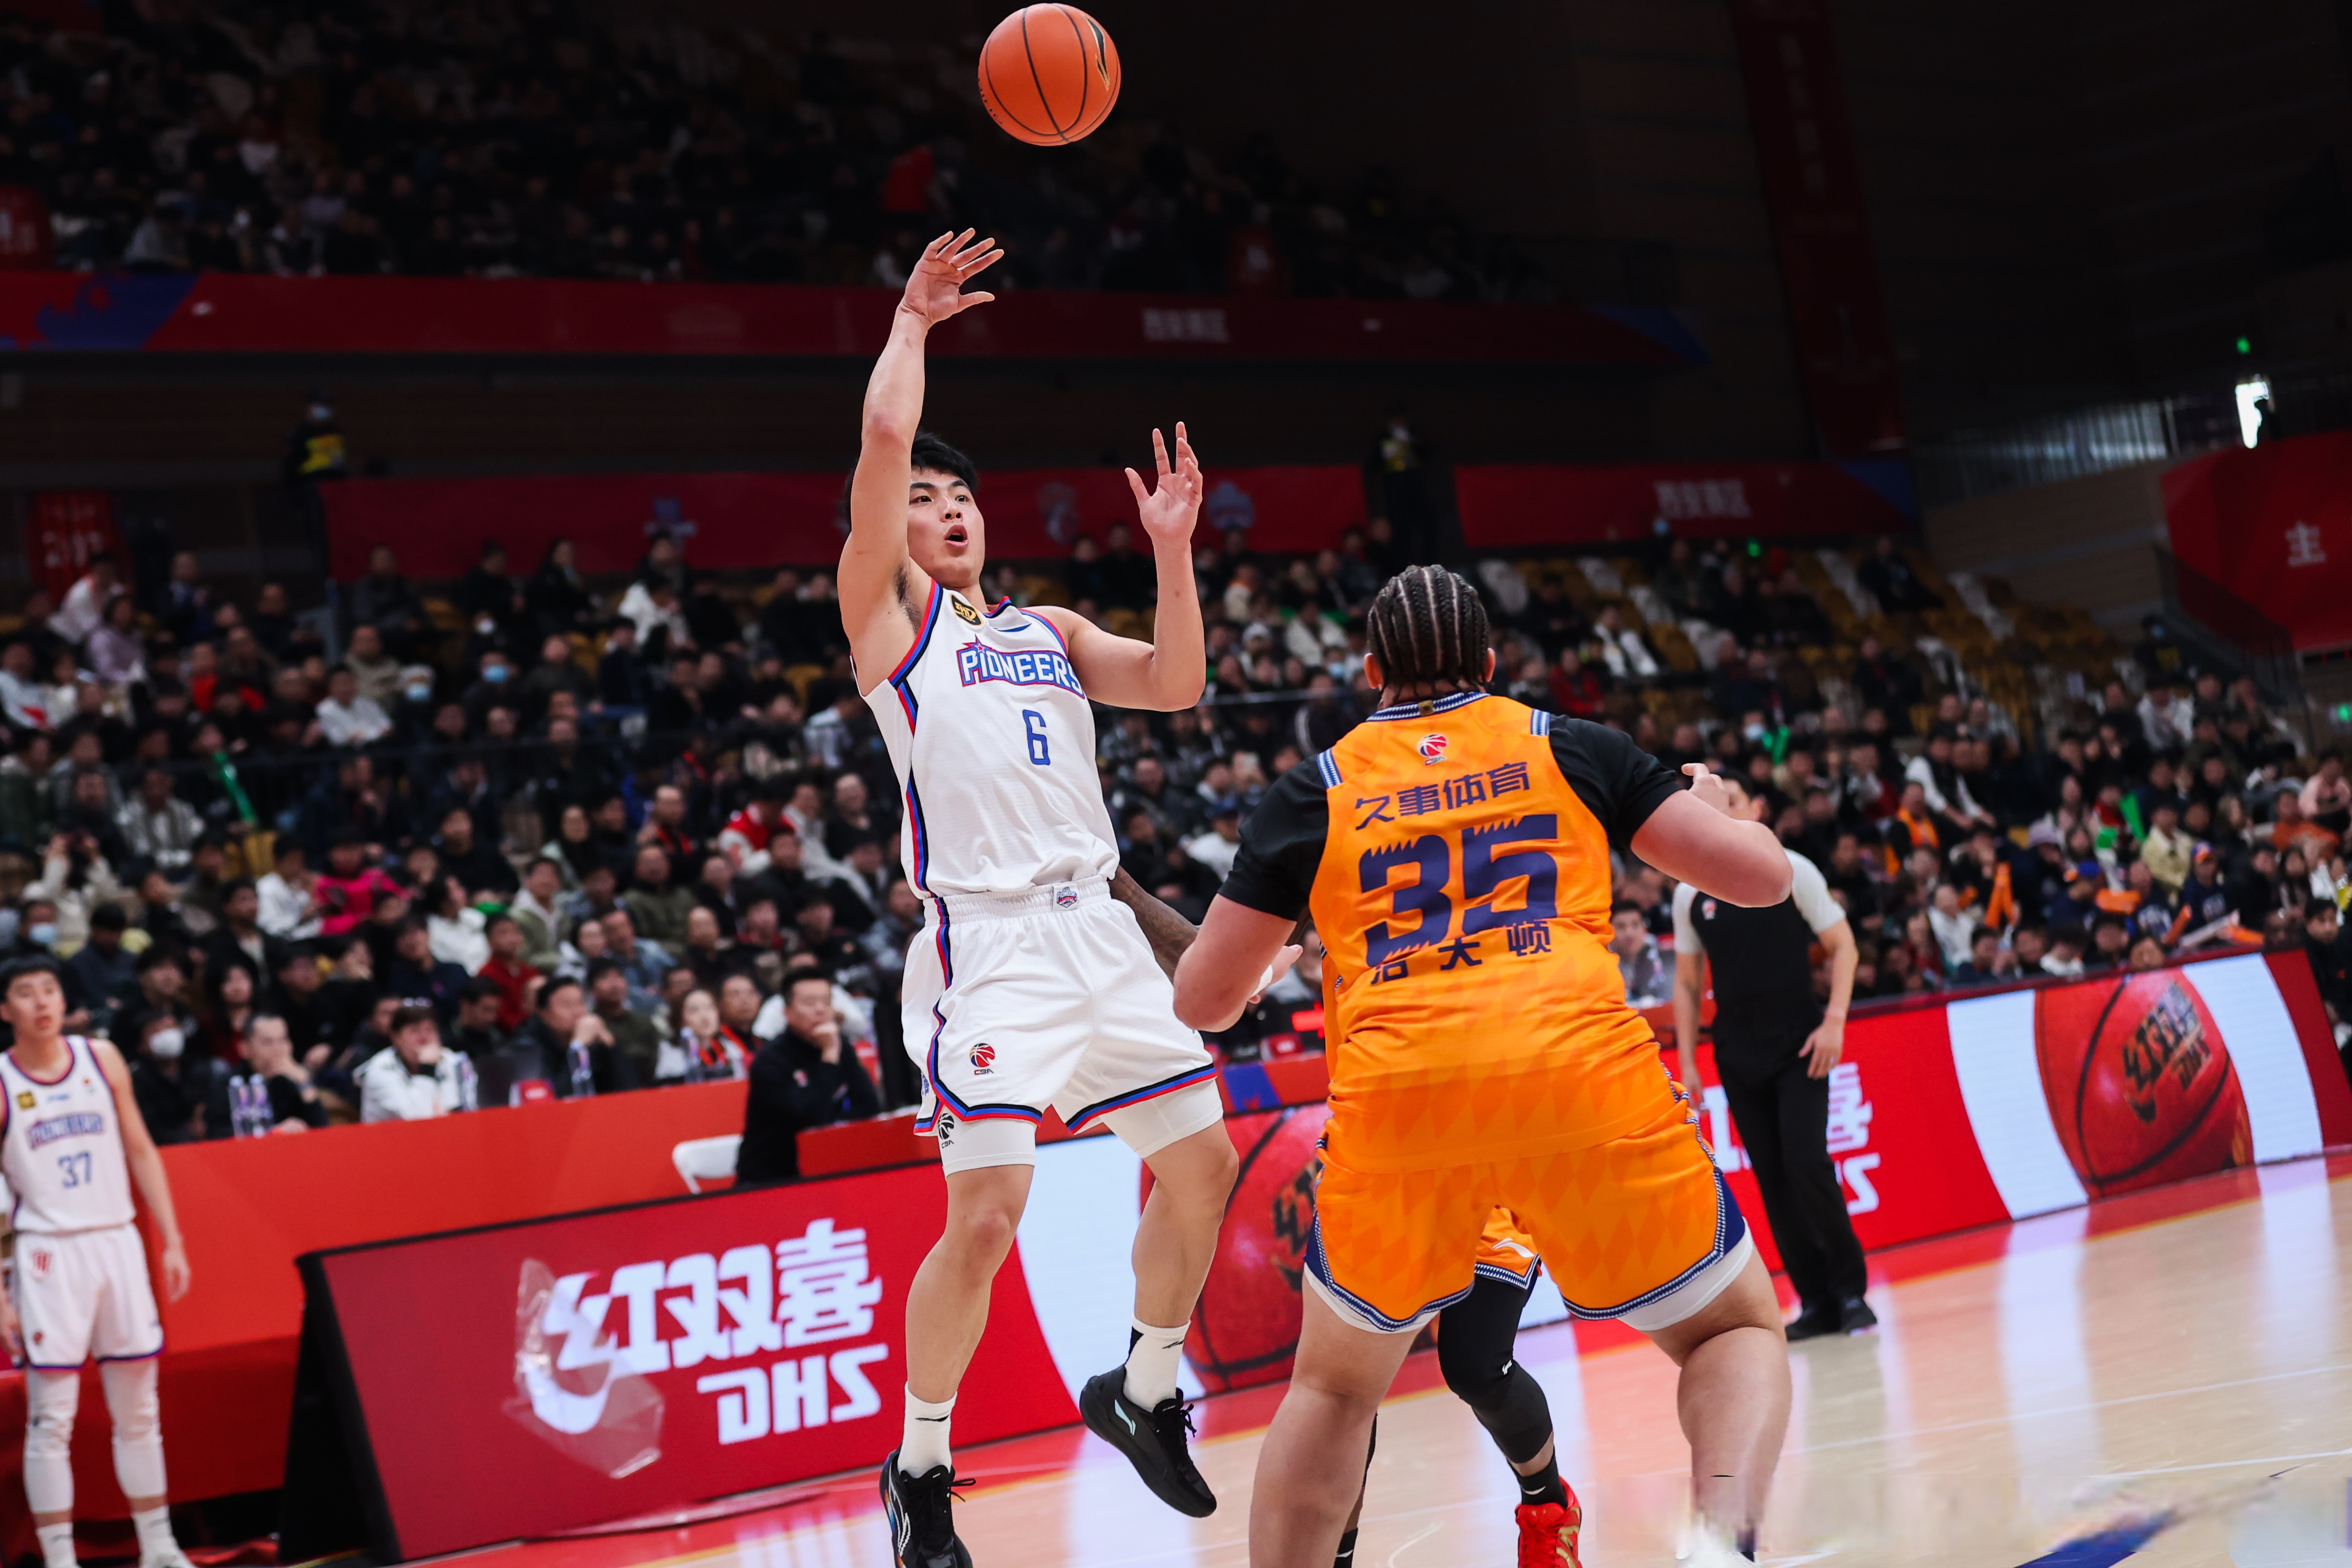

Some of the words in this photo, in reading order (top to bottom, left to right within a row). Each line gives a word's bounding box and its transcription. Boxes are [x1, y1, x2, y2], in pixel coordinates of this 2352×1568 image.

[960, 650, 1084, 691] PIONEERS
[1022, 709, 1051, 765] 6
[1354, 762, 1530, 831] 久事体育
[1359, 814, 1558, 968] 35
[58, 1151, 92, 1188] 37
[539, 1217, 883, 1373] 红双喜
[696, 1342, 889, 1445] DHS
